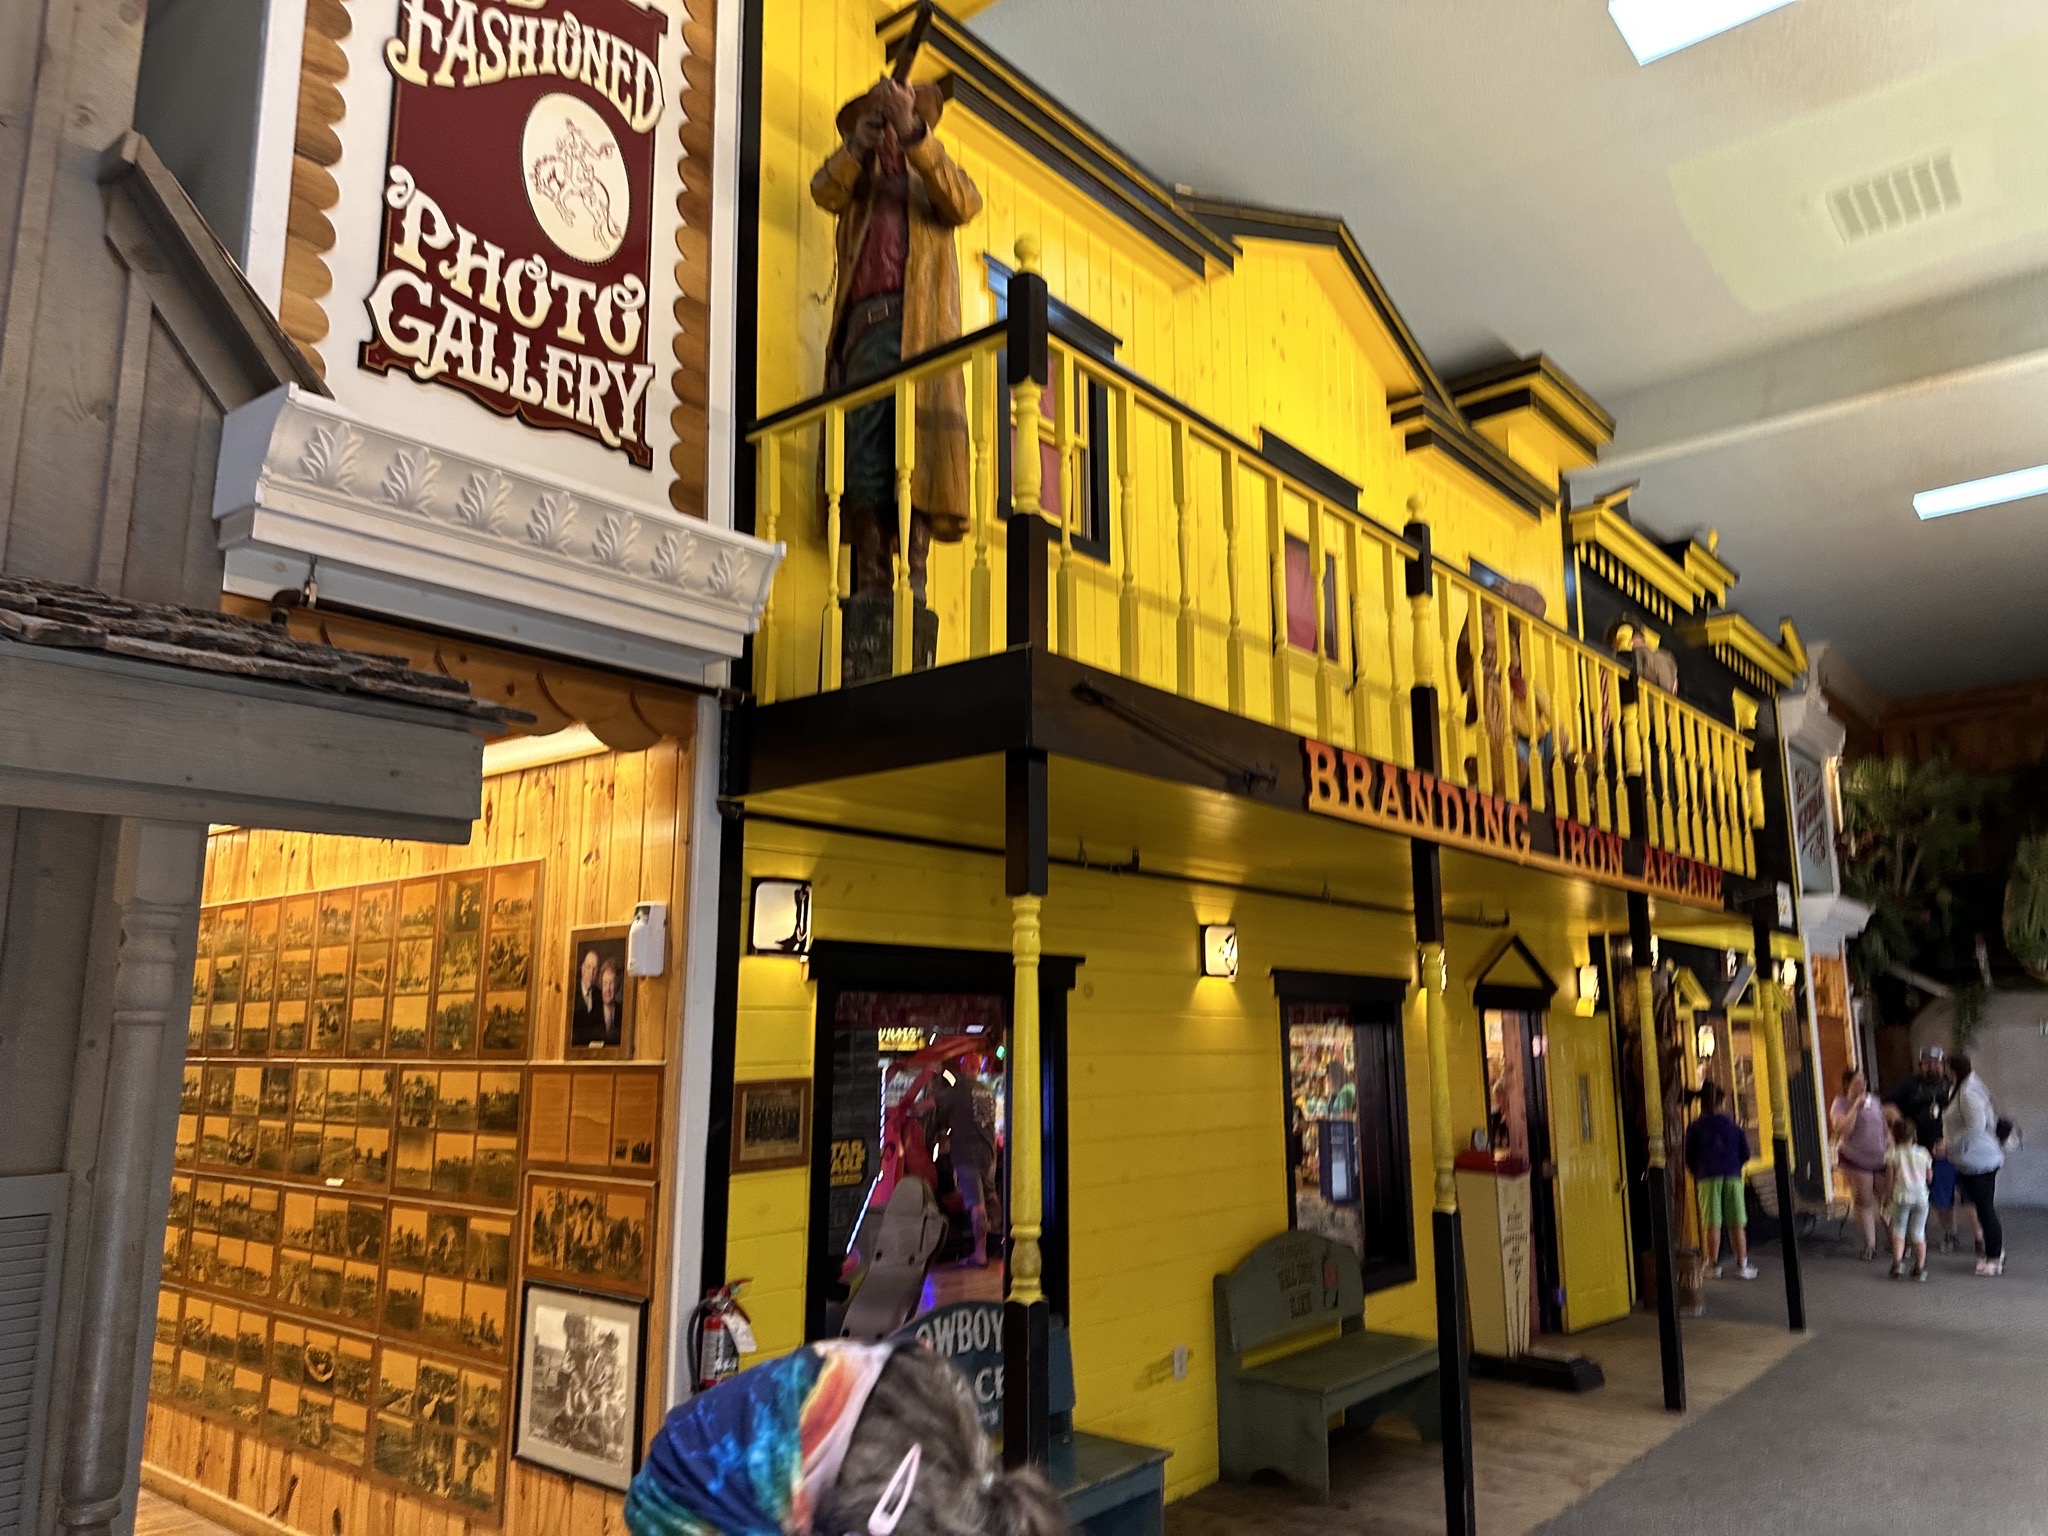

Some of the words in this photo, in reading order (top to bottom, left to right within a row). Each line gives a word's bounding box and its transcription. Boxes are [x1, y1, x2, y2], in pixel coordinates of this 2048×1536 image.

[386, 0, 664, 133] FASHIONED
[386, 165, 645, 355] PHOTO
[366, 270, 655, 447] GALLERY
[1305, 739, 1530, 857] BRANDING
[1556, 819, 1623, 879] IRON
[1643, 843, 1725, 901] ARCADE
[915, 1307, 1004, 1356] OWBOY
